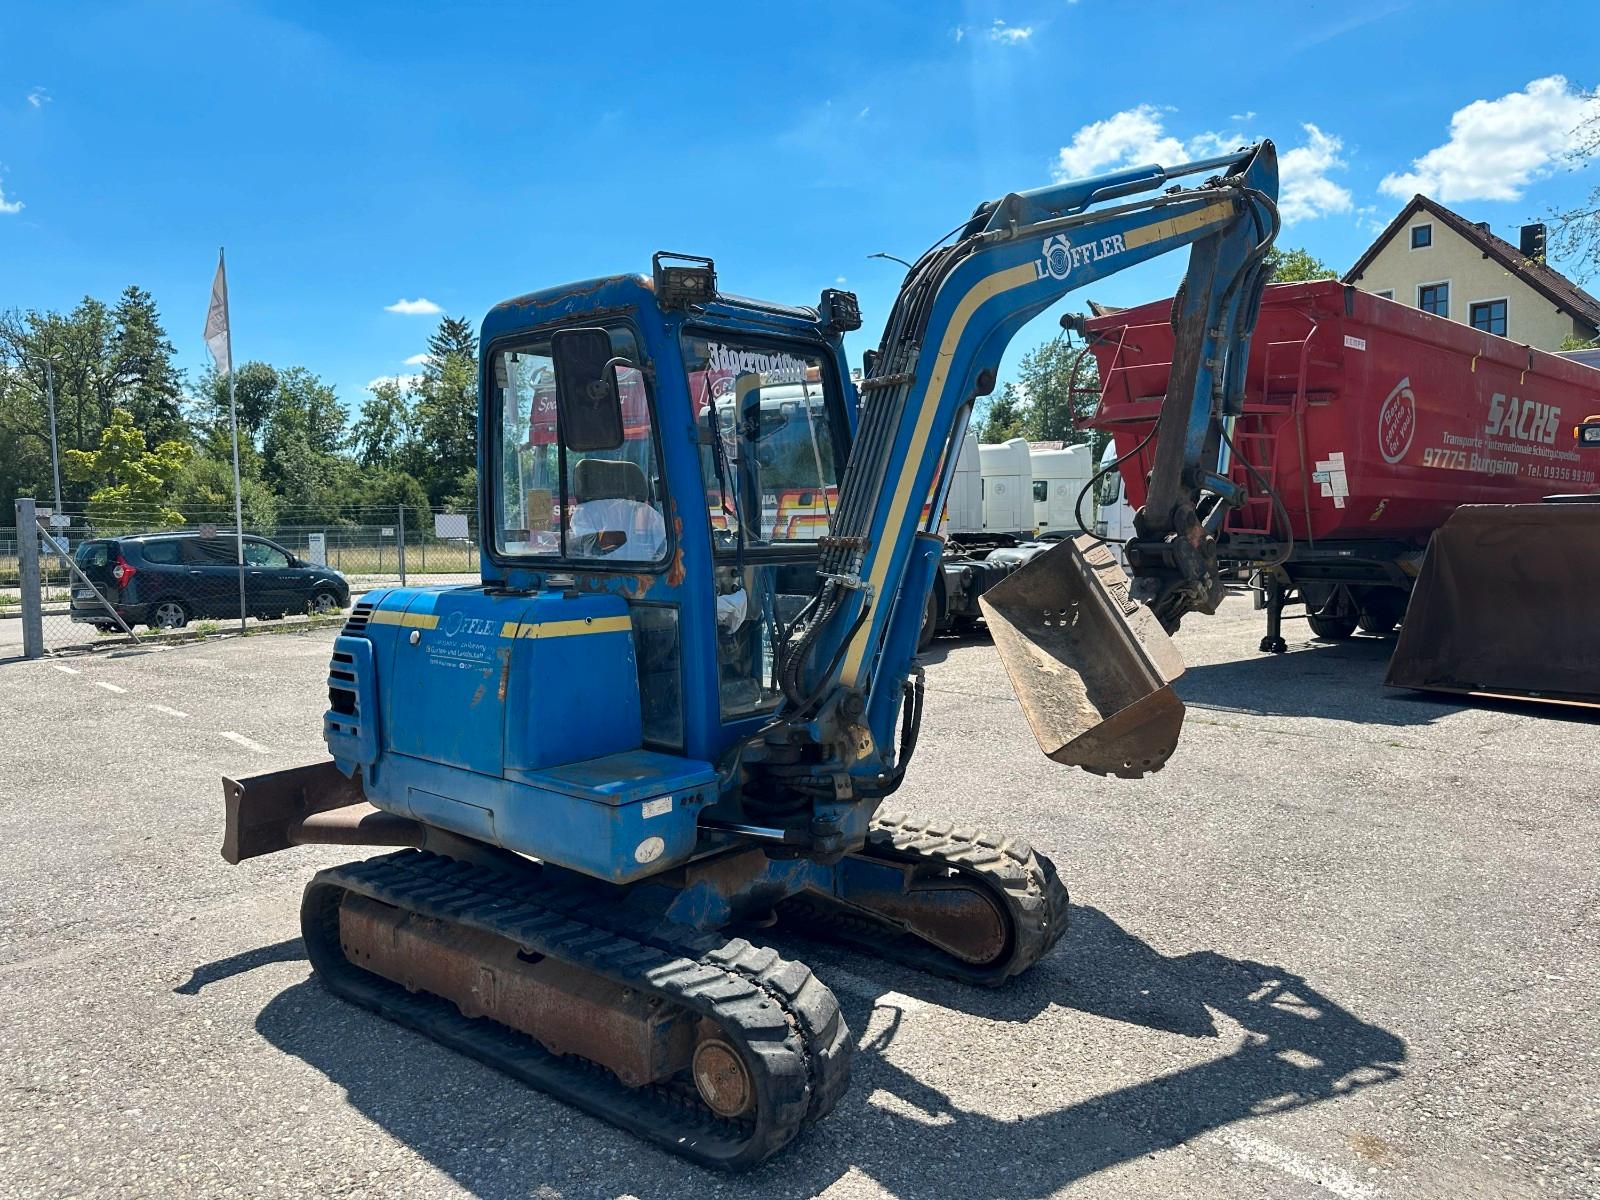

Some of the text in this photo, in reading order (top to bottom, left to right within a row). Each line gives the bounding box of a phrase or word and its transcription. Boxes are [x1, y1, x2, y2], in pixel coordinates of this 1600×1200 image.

[1384, 395, 1400, 425] Best
[1485, 392, 1561, 445] SACHS
[1443, 431, 1483, 448] Transporte
[1423, 447, 1467, 470] 97775
[1470, 452, 1519, 477] Burgsinn
[1527, 464, 1543, 477] Tel.
